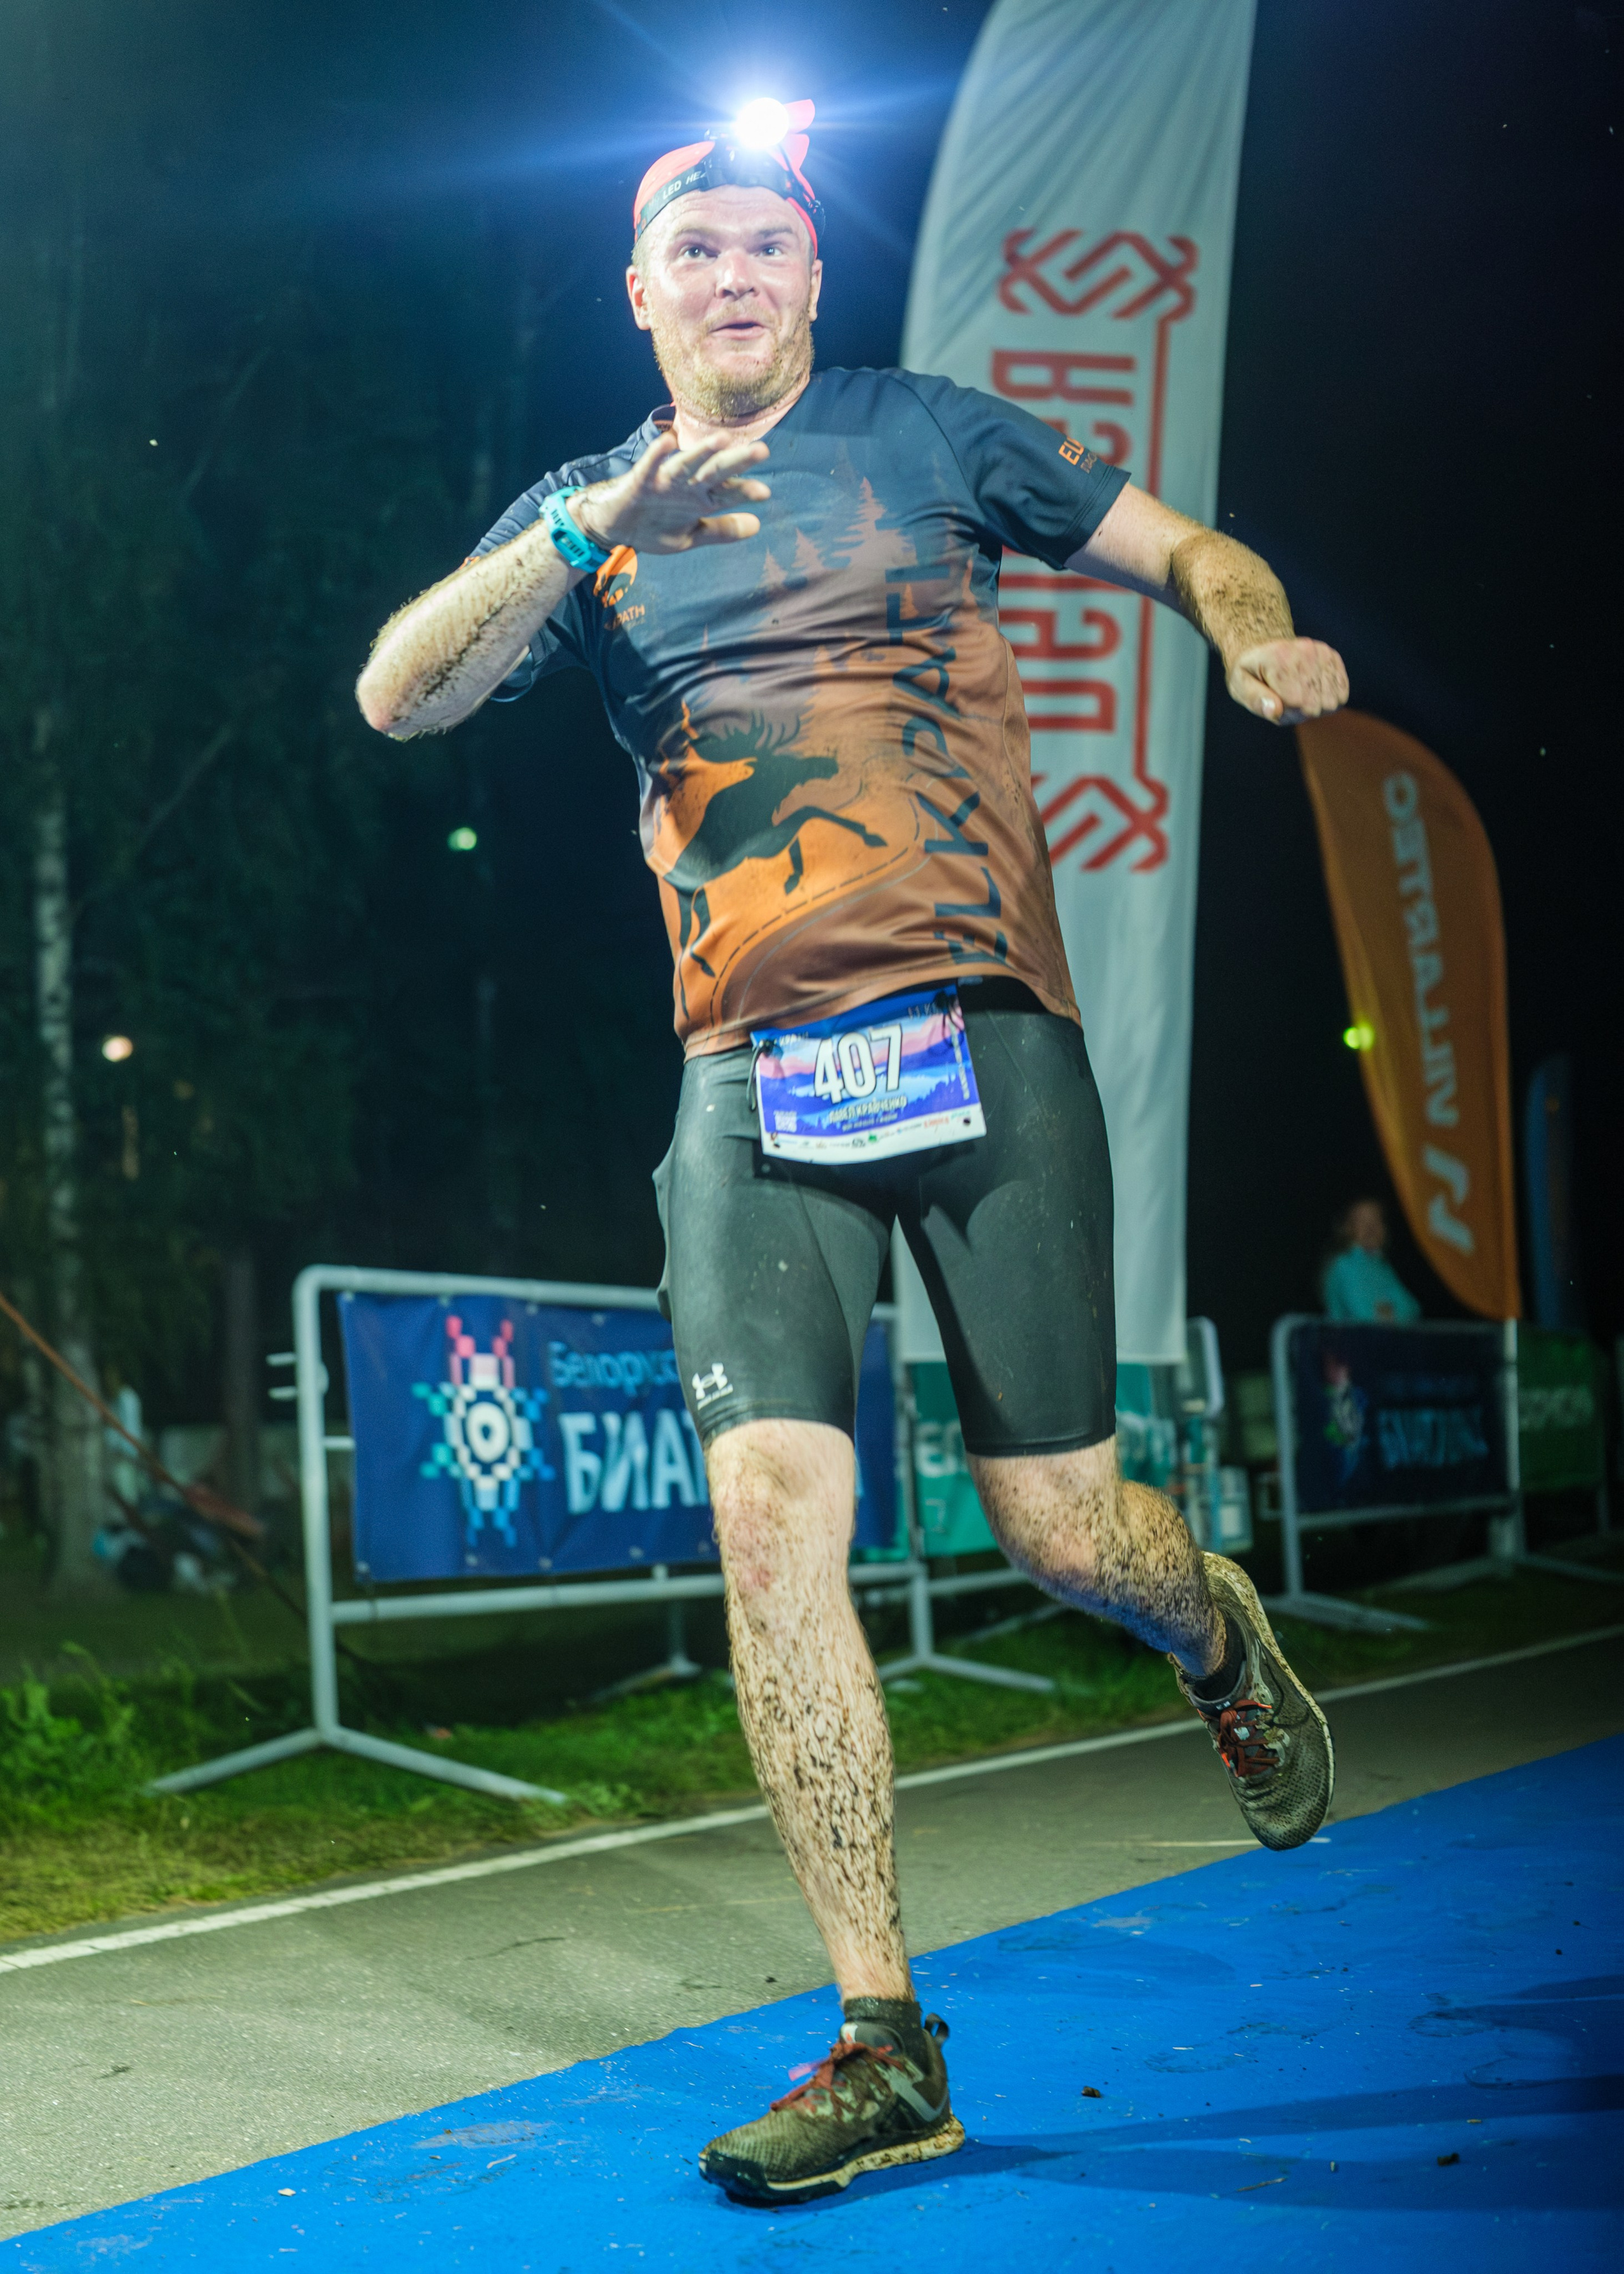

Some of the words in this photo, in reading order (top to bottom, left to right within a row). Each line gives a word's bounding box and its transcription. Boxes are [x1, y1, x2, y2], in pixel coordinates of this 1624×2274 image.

[662, 180, 682, 200] LED
[915, 790, 1010, 967] ELK
[814, 1023, 902, 1104] 407
[558, 1408, 710, 1517] БИАТ
